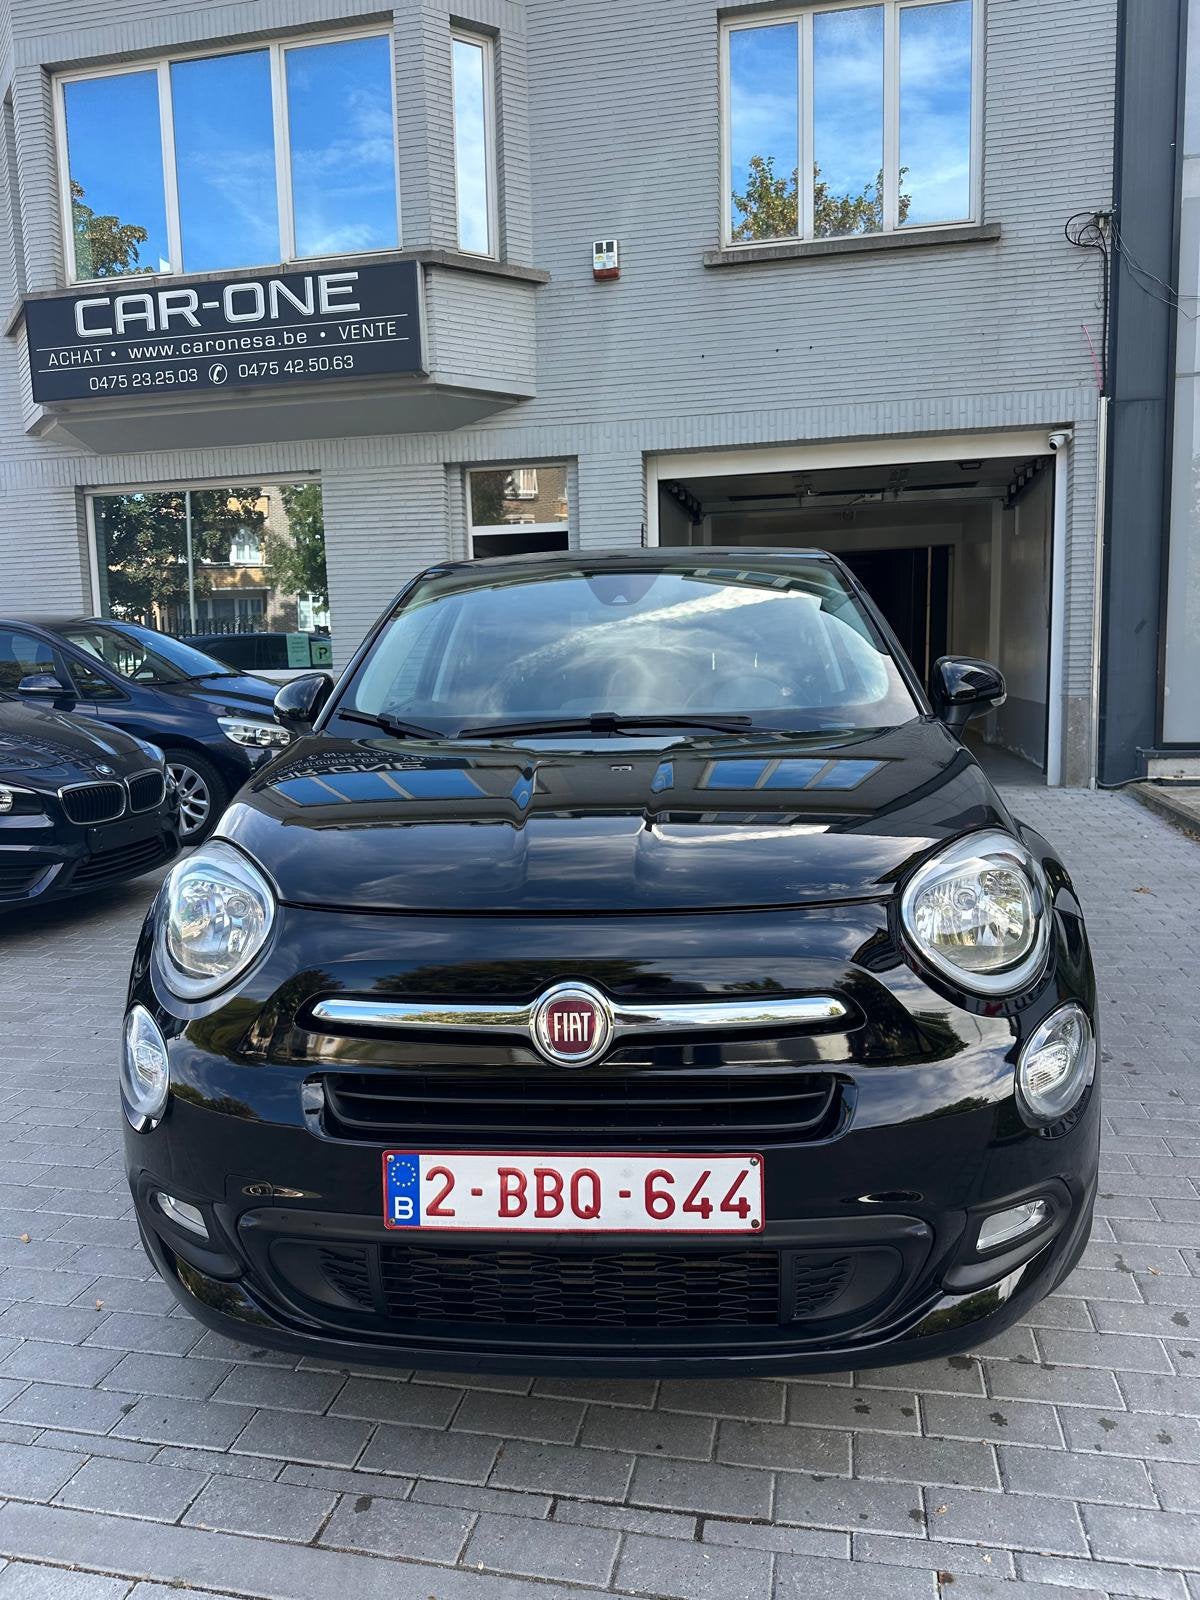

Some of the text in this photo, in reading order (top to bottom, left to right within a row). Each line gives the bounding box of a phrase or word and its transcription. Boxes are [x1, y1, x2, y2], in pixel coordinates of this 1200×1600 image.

[74, 271, 361, 338] CAR-ONE
[48, 321, 398, 367] ACHAT www.caronesa.be VENTE
[89, 355, 354, 391] 0475 23.25.03 0475 42.50.63
[553, 1012, 592, 1042] FIAT
[394, 1196, 414, 1220] B
